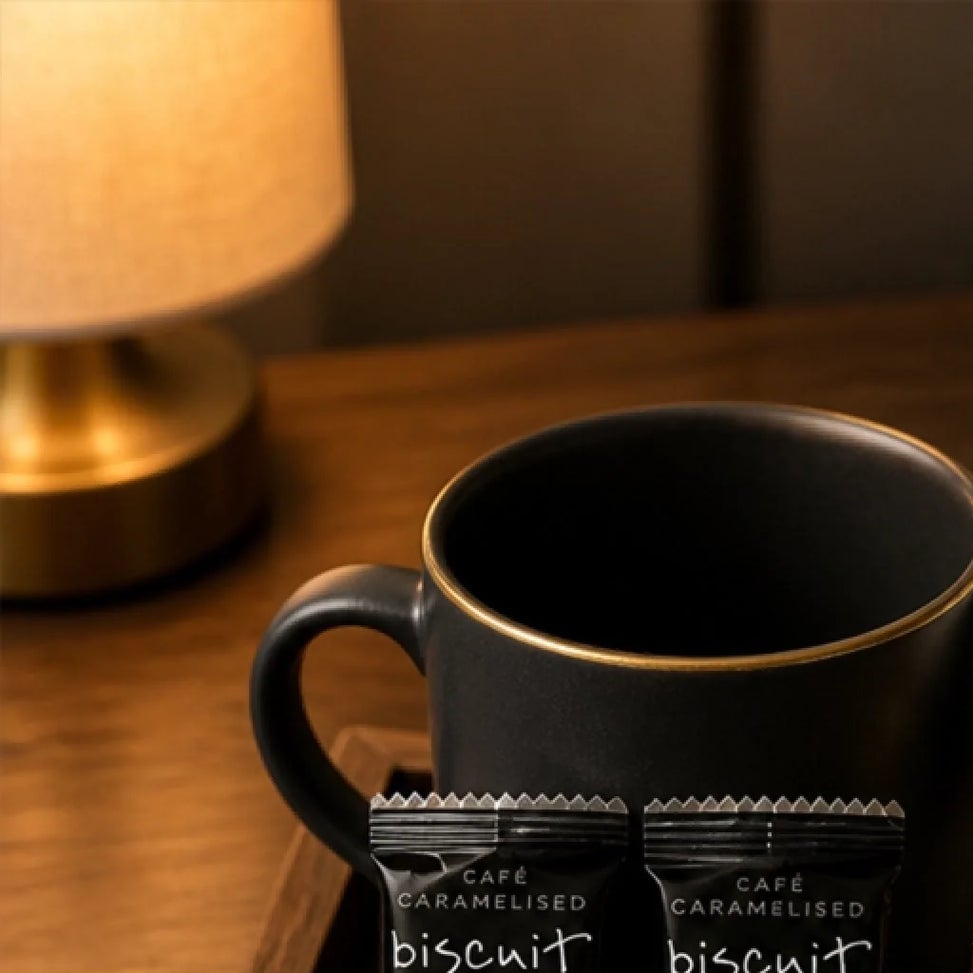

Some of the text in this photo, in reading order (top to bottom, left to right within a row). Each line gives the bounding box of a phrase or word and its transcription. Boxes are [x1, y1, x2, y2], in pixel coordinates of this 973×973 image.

[462, 866, 527, 884] CAFÉ
[736, 873, 803, 892] CAFÉ
[398, 892, 586, 911] CARAMELISED
[670, 899, 864, 917] CARAMELISED
